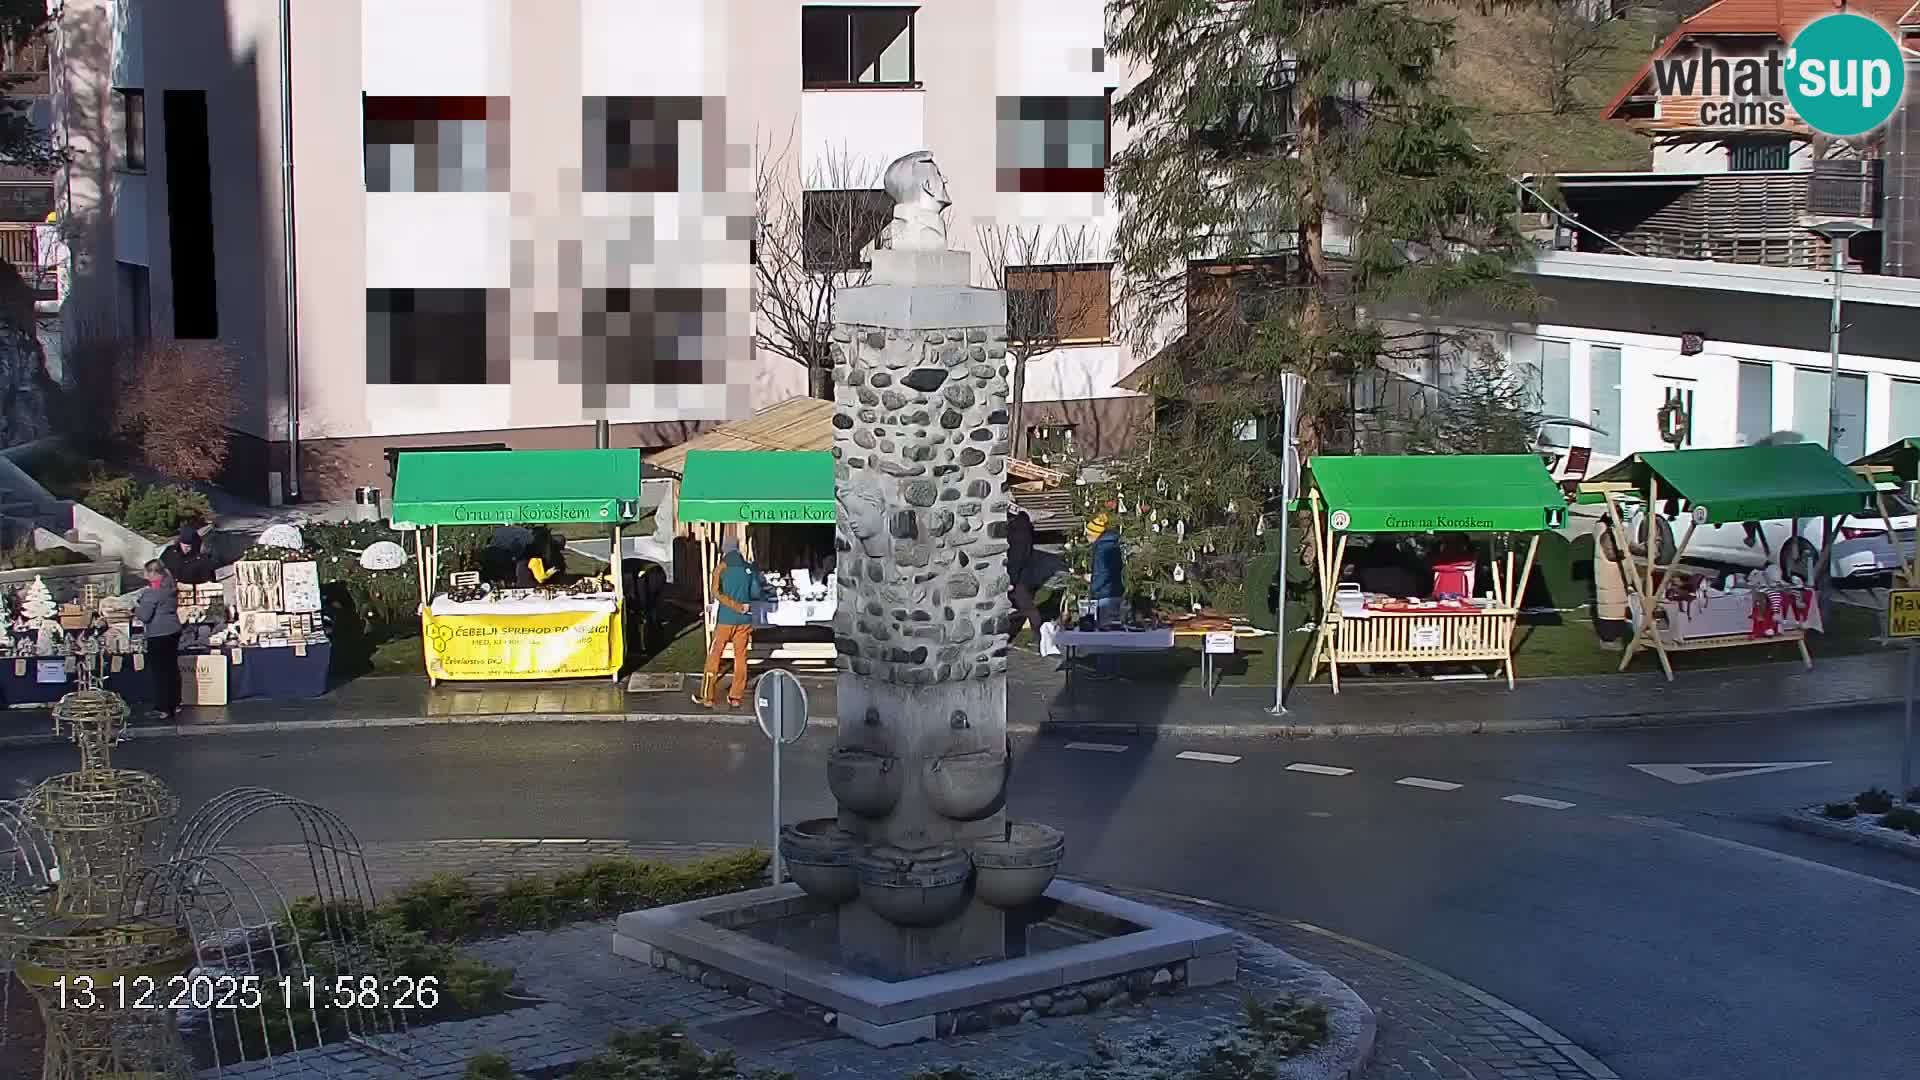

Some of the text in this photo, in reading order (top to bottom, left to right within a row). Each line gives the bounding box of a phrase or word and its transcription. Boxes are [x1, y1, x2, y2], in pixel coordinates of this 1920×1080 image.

[454, 502, 591, 521] Črna na Koroškem
[739, 502, 775, 520] Črna
[780, 509, 800, 520] na
[1385, 513, 1494, 529] Črna na Koroškem
[455, 625, 497, 637] ČEBELJI
